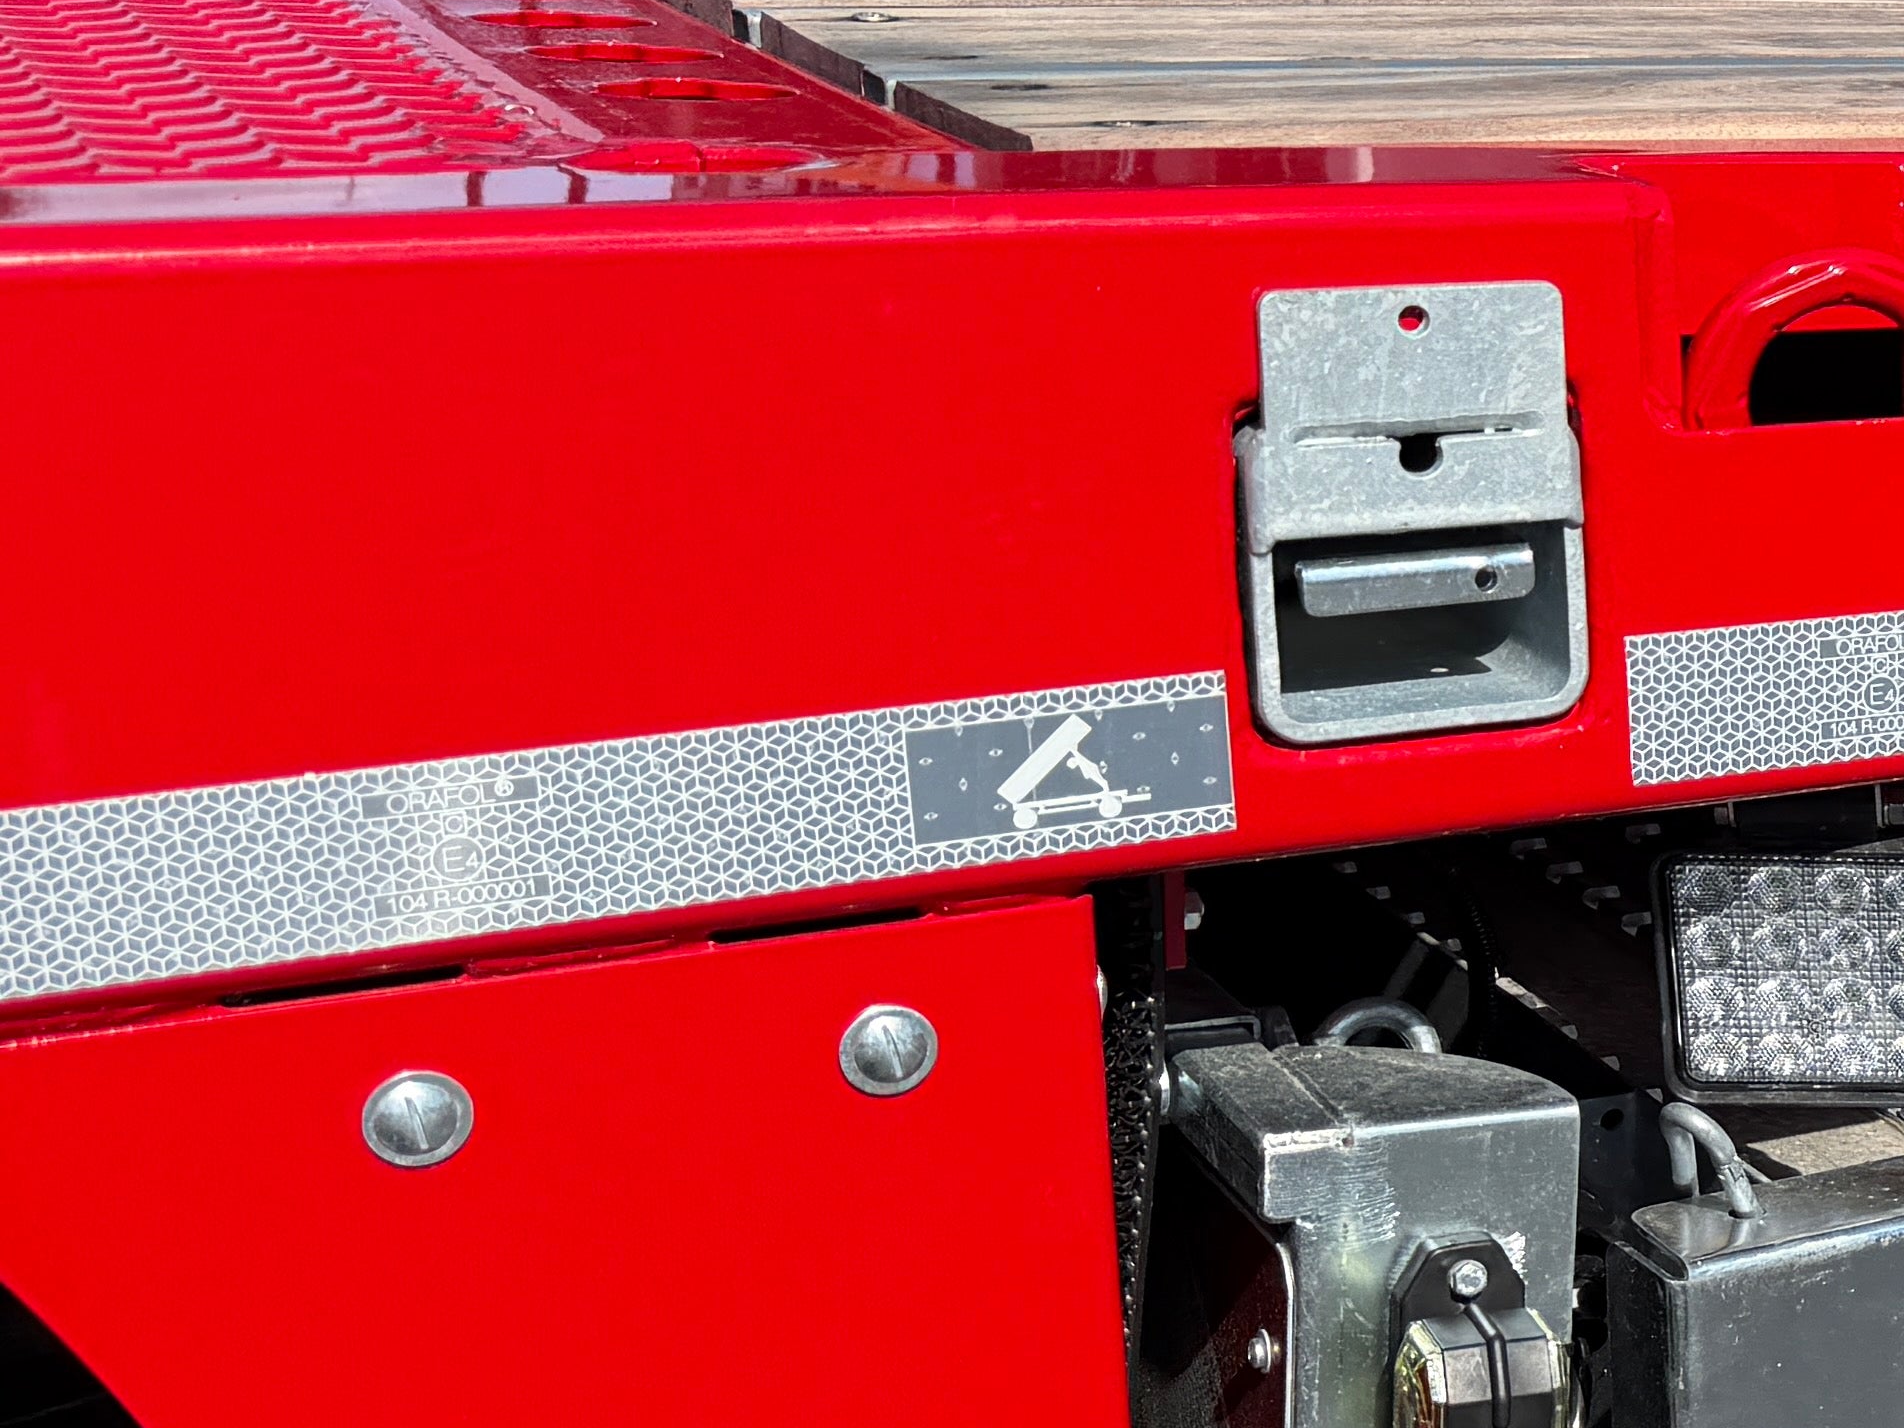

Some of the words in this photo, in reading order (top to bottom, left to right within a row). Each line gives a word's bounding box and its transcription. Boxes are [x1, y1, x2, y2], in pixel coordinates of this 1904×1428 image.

[1829, 720, 1858, 738] 104
[441, 844, 482, 873] E4
[386, 894, 429, 915] 104
[432, 877, 538, 909] R-000001
